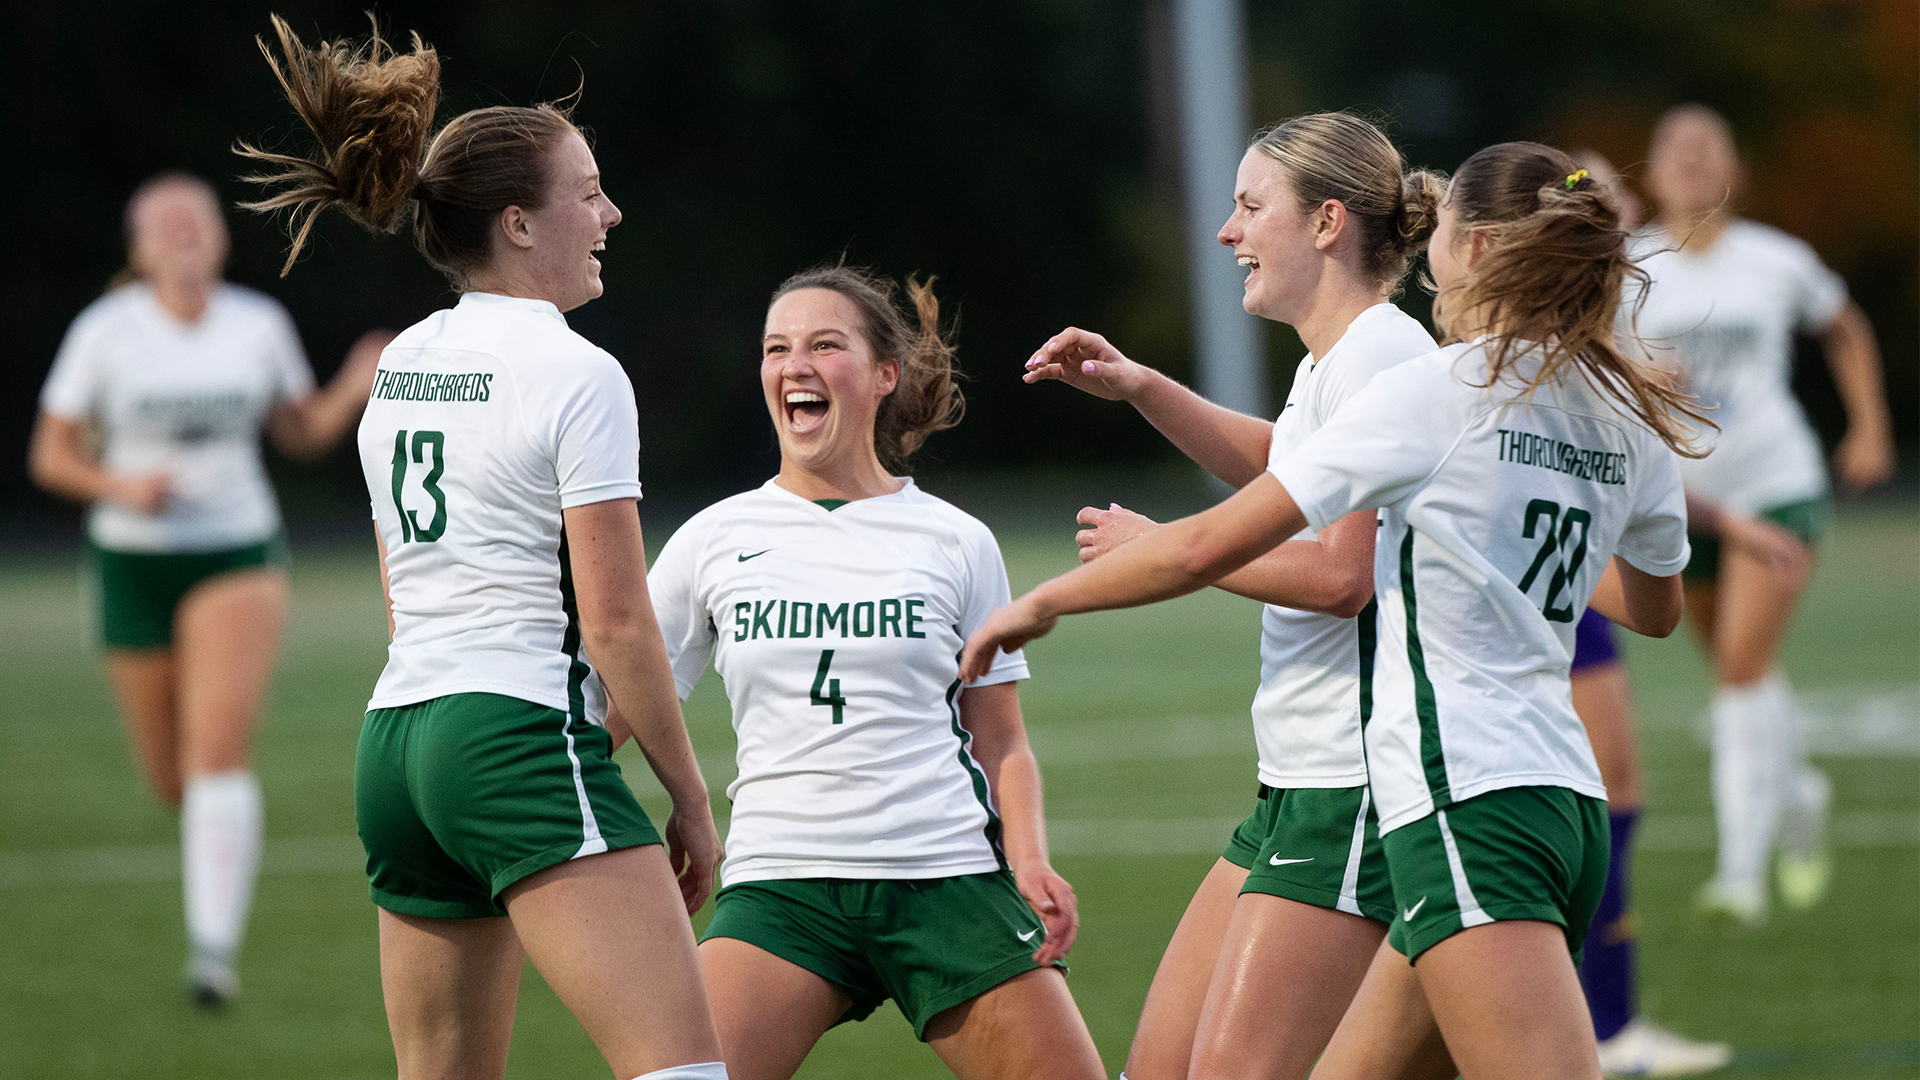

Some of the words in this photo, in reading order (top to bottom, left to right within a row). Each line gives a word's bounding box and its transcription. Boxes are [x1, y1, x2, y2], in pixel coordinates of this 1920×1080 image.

[371, 368, 494, 402] THOROUGHBREDS
[1497, 429, 1626, 485] THOROUGHBREDS
[391, 429, 447, 544] 13
[734, 598, 927, 643] SKIDMORE
[809, 649, 847, 725] 4
